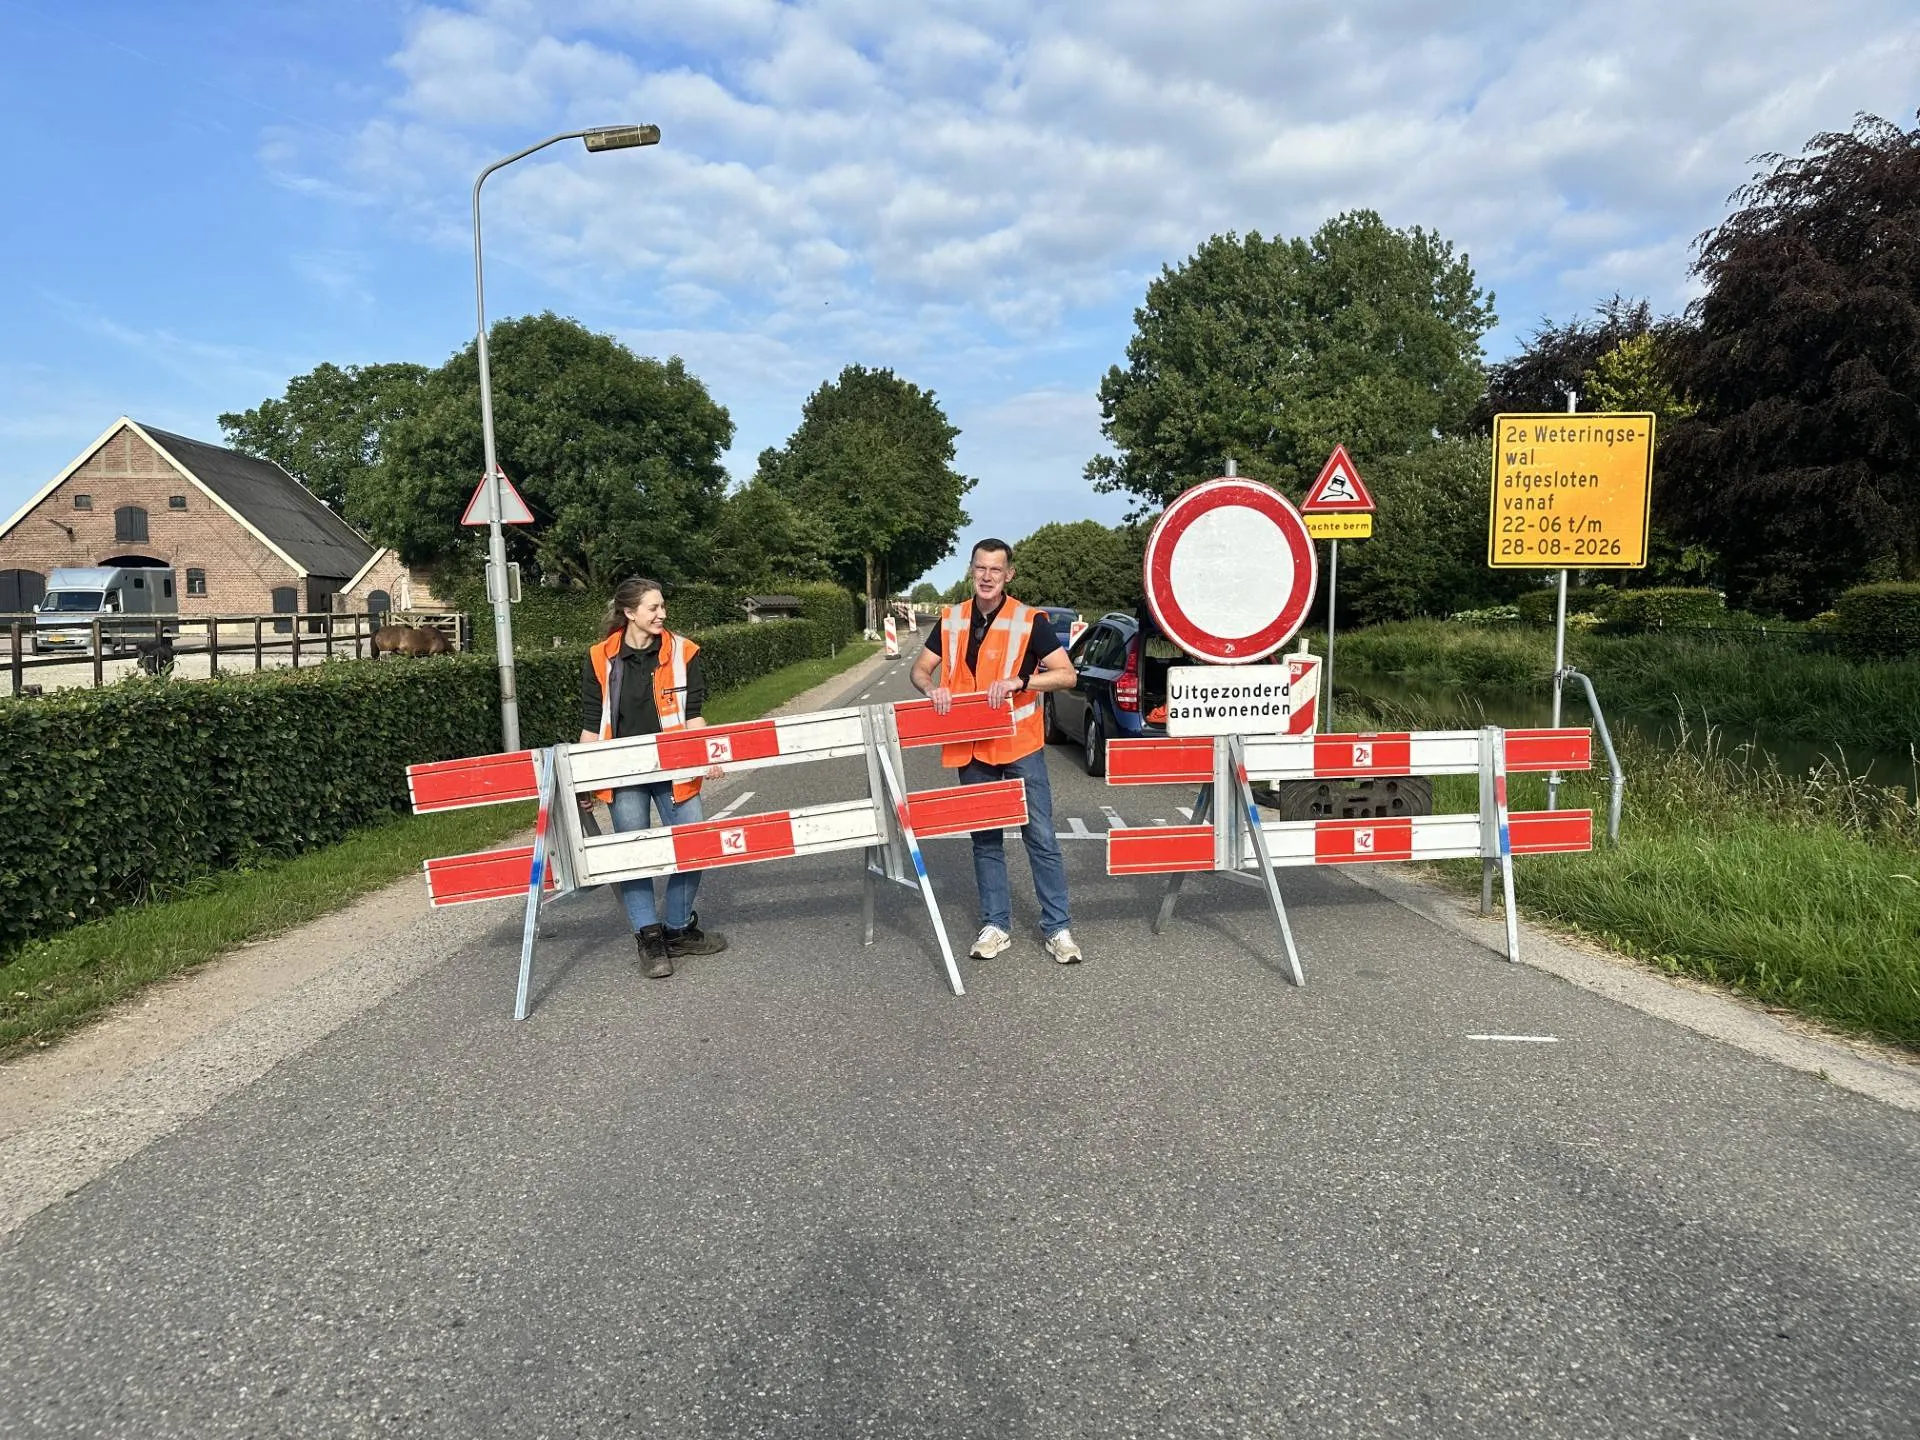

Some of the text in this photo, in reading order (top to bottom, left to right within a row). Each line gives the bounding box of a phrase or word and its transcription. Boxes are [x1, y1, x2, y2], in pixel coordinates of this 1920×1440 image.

[1506, 425, 1645, 447] 2e Weteringse-
[1505, 448, 1534, 465] wal
[1504, 471, 1599, 492] afgesloten
[1503, 493, 1554, 510] vanaf
[1343, 522, 1369, 530] berm
[1502, 515, 1602, 534] 22-06 t/m
[1501, 538, 1621, 555] 28-08-2026
[1171, 682, 1290, 703] Uitgezonderd
[1169, 702, 1291, 719] aanwonenden
